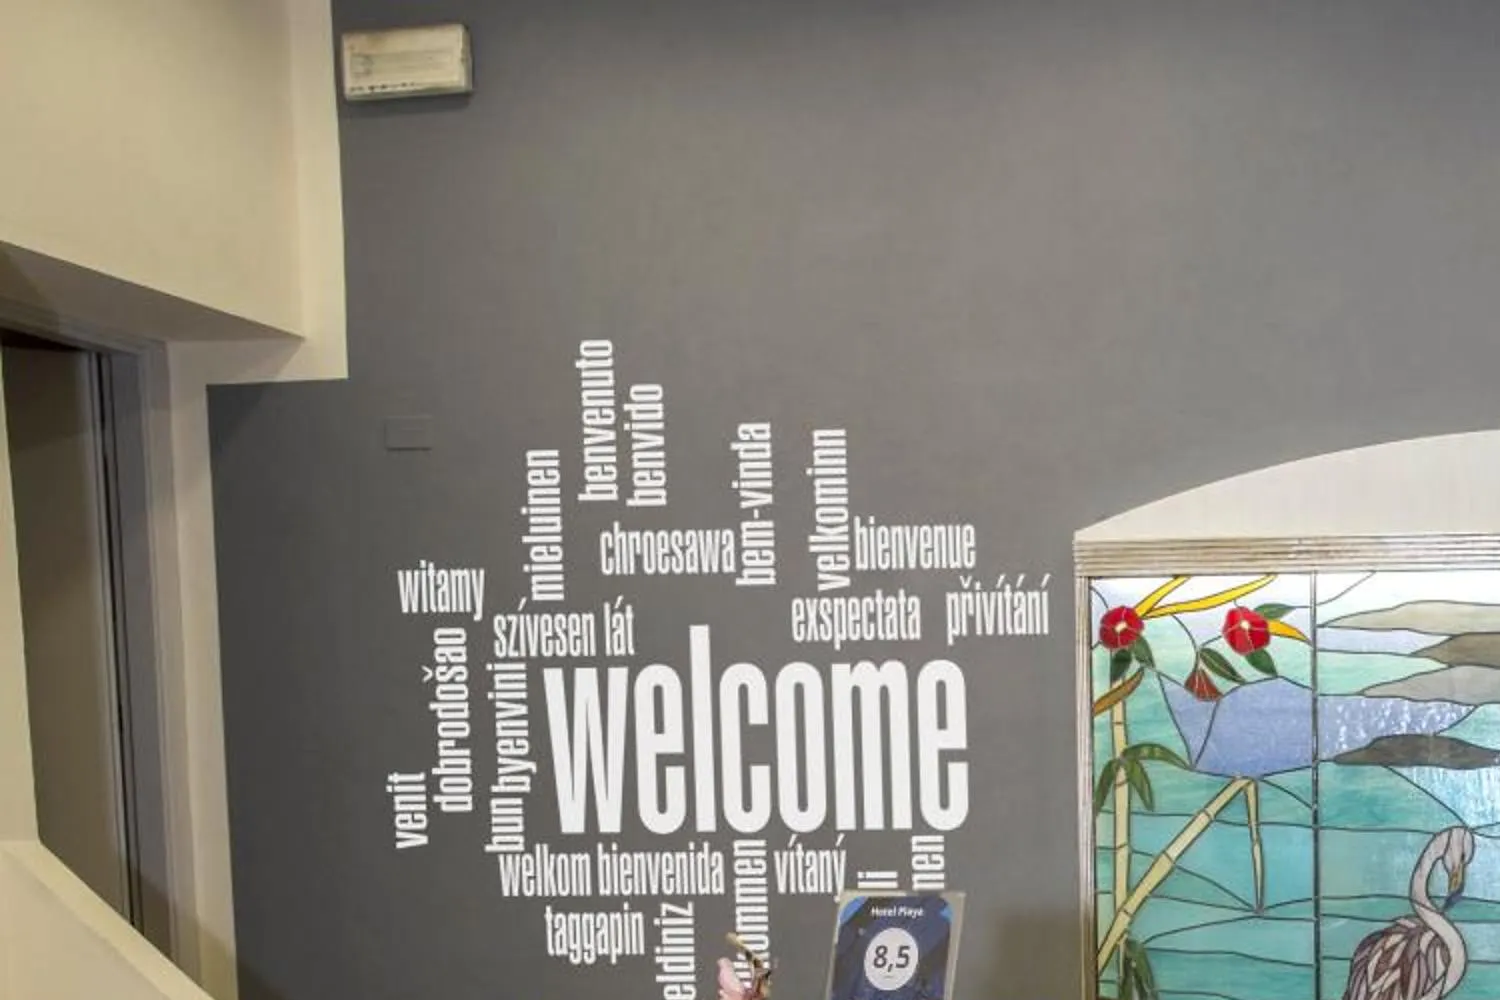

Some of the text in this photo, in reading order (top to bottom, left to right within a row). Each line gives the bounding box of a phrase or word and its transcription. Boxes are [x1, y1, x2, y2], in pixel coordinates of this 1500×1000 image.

[575, 339, 619, 501] benvenuto
[623, 383, 667, 507] benvido
[521, 449, 565, 601] mieluinen
[730, 422, 776, 586] bem-vinda
[805, 428, 851, 592] velkominn
[599, 521, 736, 576] chroesawa
[853, 515, 976, 571] bienvenue
[397, 559, 485, 621] witamy
[791, 588, 922, 651] exspectata
[945, 573, 1051, 646] přivítání
[493, 595, 635, 658] szívesen lát
[422, 627, 473, 812] dobrodošao
[486, 663, 537, 793] byenvini
[543, 624, 969, 835] welcome
[386, 772, 428, 849] venit
[485, 797, 525, 852] bun
[498, 843, 592, 897] welkom
[597, 841, 725, 896] bienvenida
[773, 833, 846, 902] vítaný
[544, 902, 645, 965] taggapin
[873, 945, 911, 973] 8,5
